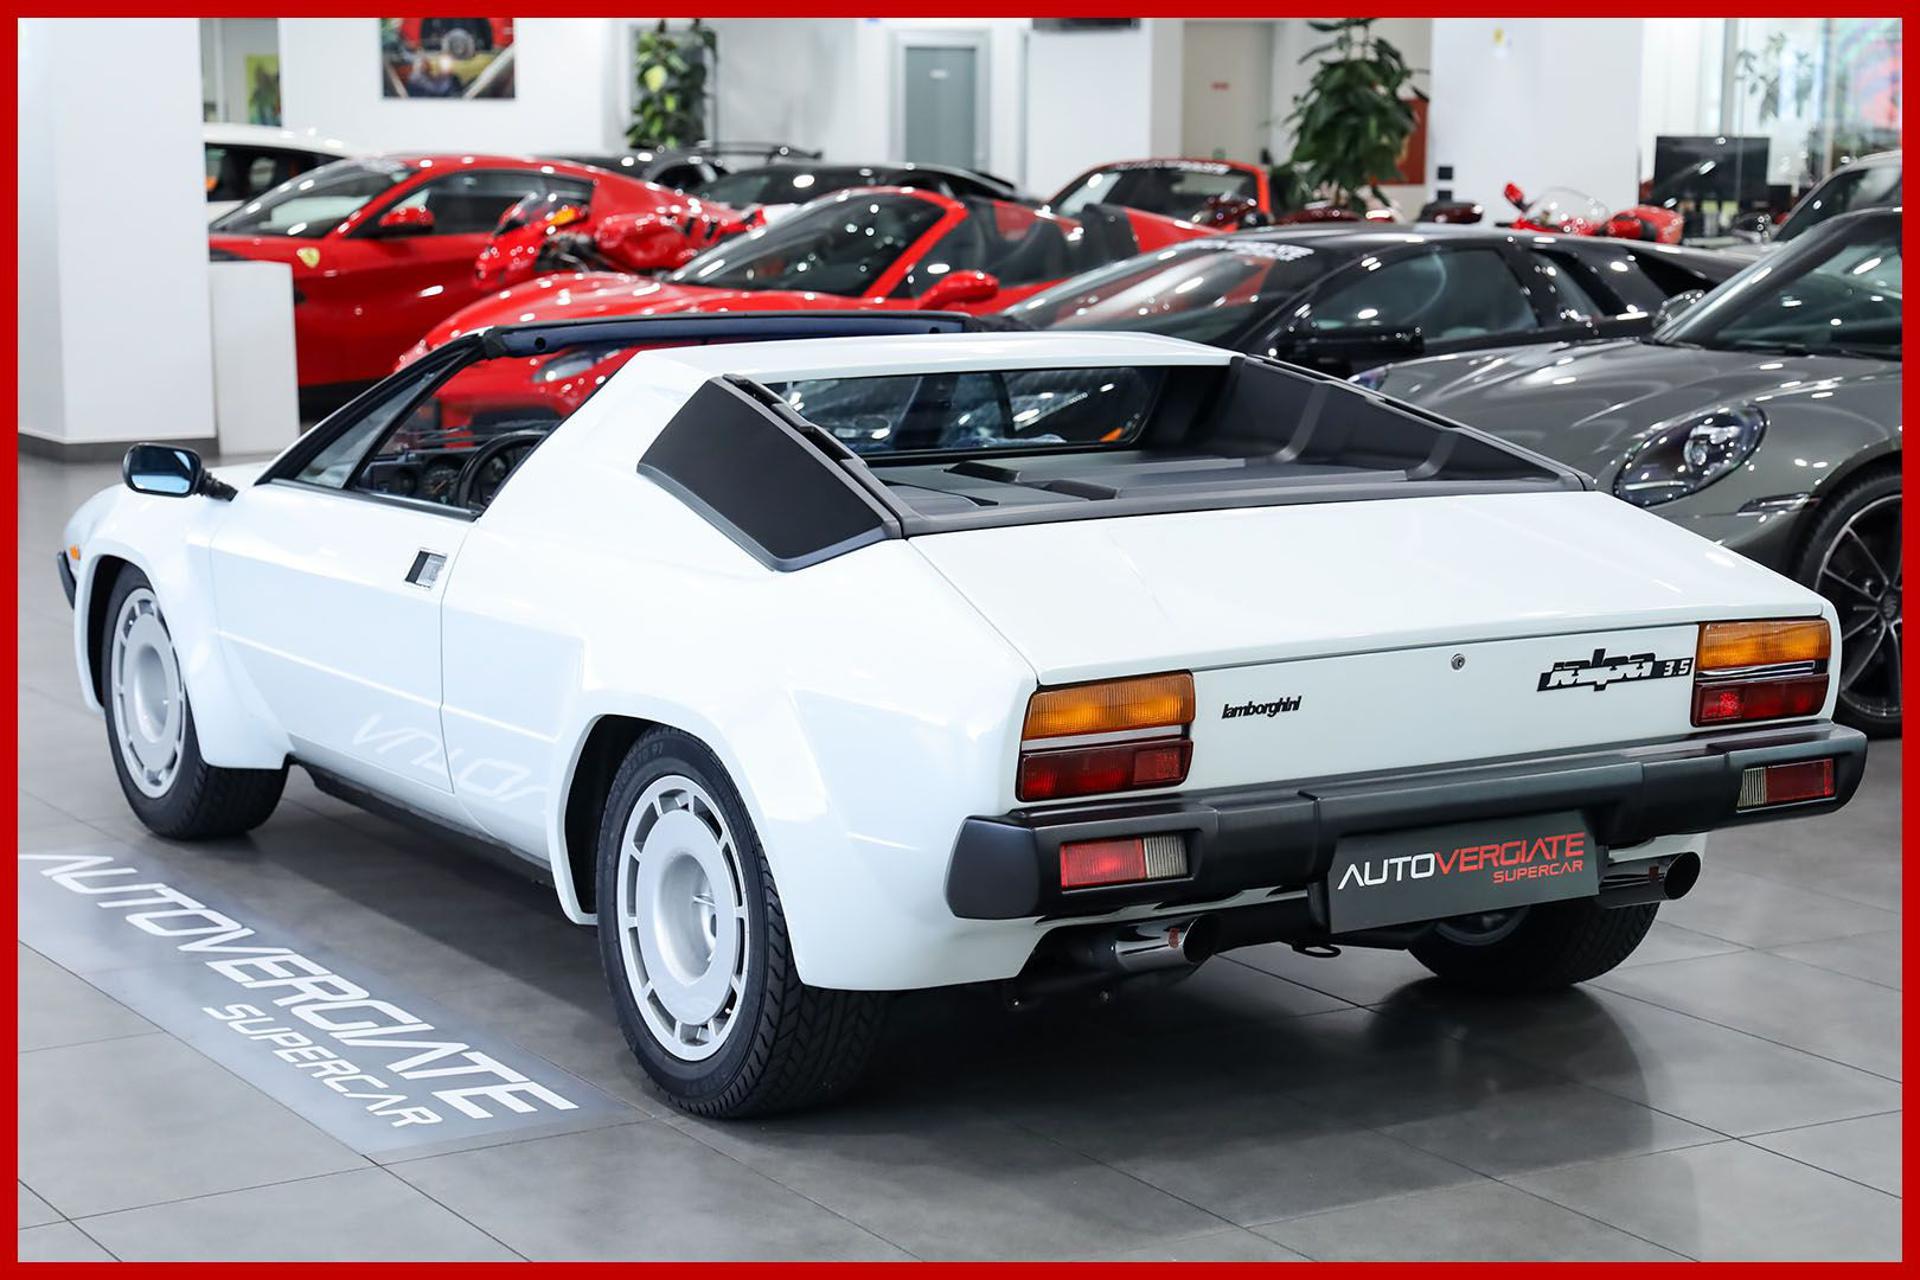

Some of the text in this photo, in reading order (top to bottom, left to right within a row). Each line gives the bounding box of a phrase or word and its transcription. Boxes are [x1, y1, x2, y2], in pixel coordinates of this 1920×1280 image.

[1663, 659, 1692, 678] 3.5
[1222, 695, 1302, 719] lamborghini
[1337, 832, 1585, 890] AUTOVERGIATE
[1493, 860, 1583, 884] SUPERCAR
[18, 855, 578, 1119] AUTOVERGIATE
[202, 1003, 443, 1128] SUPERCAR
